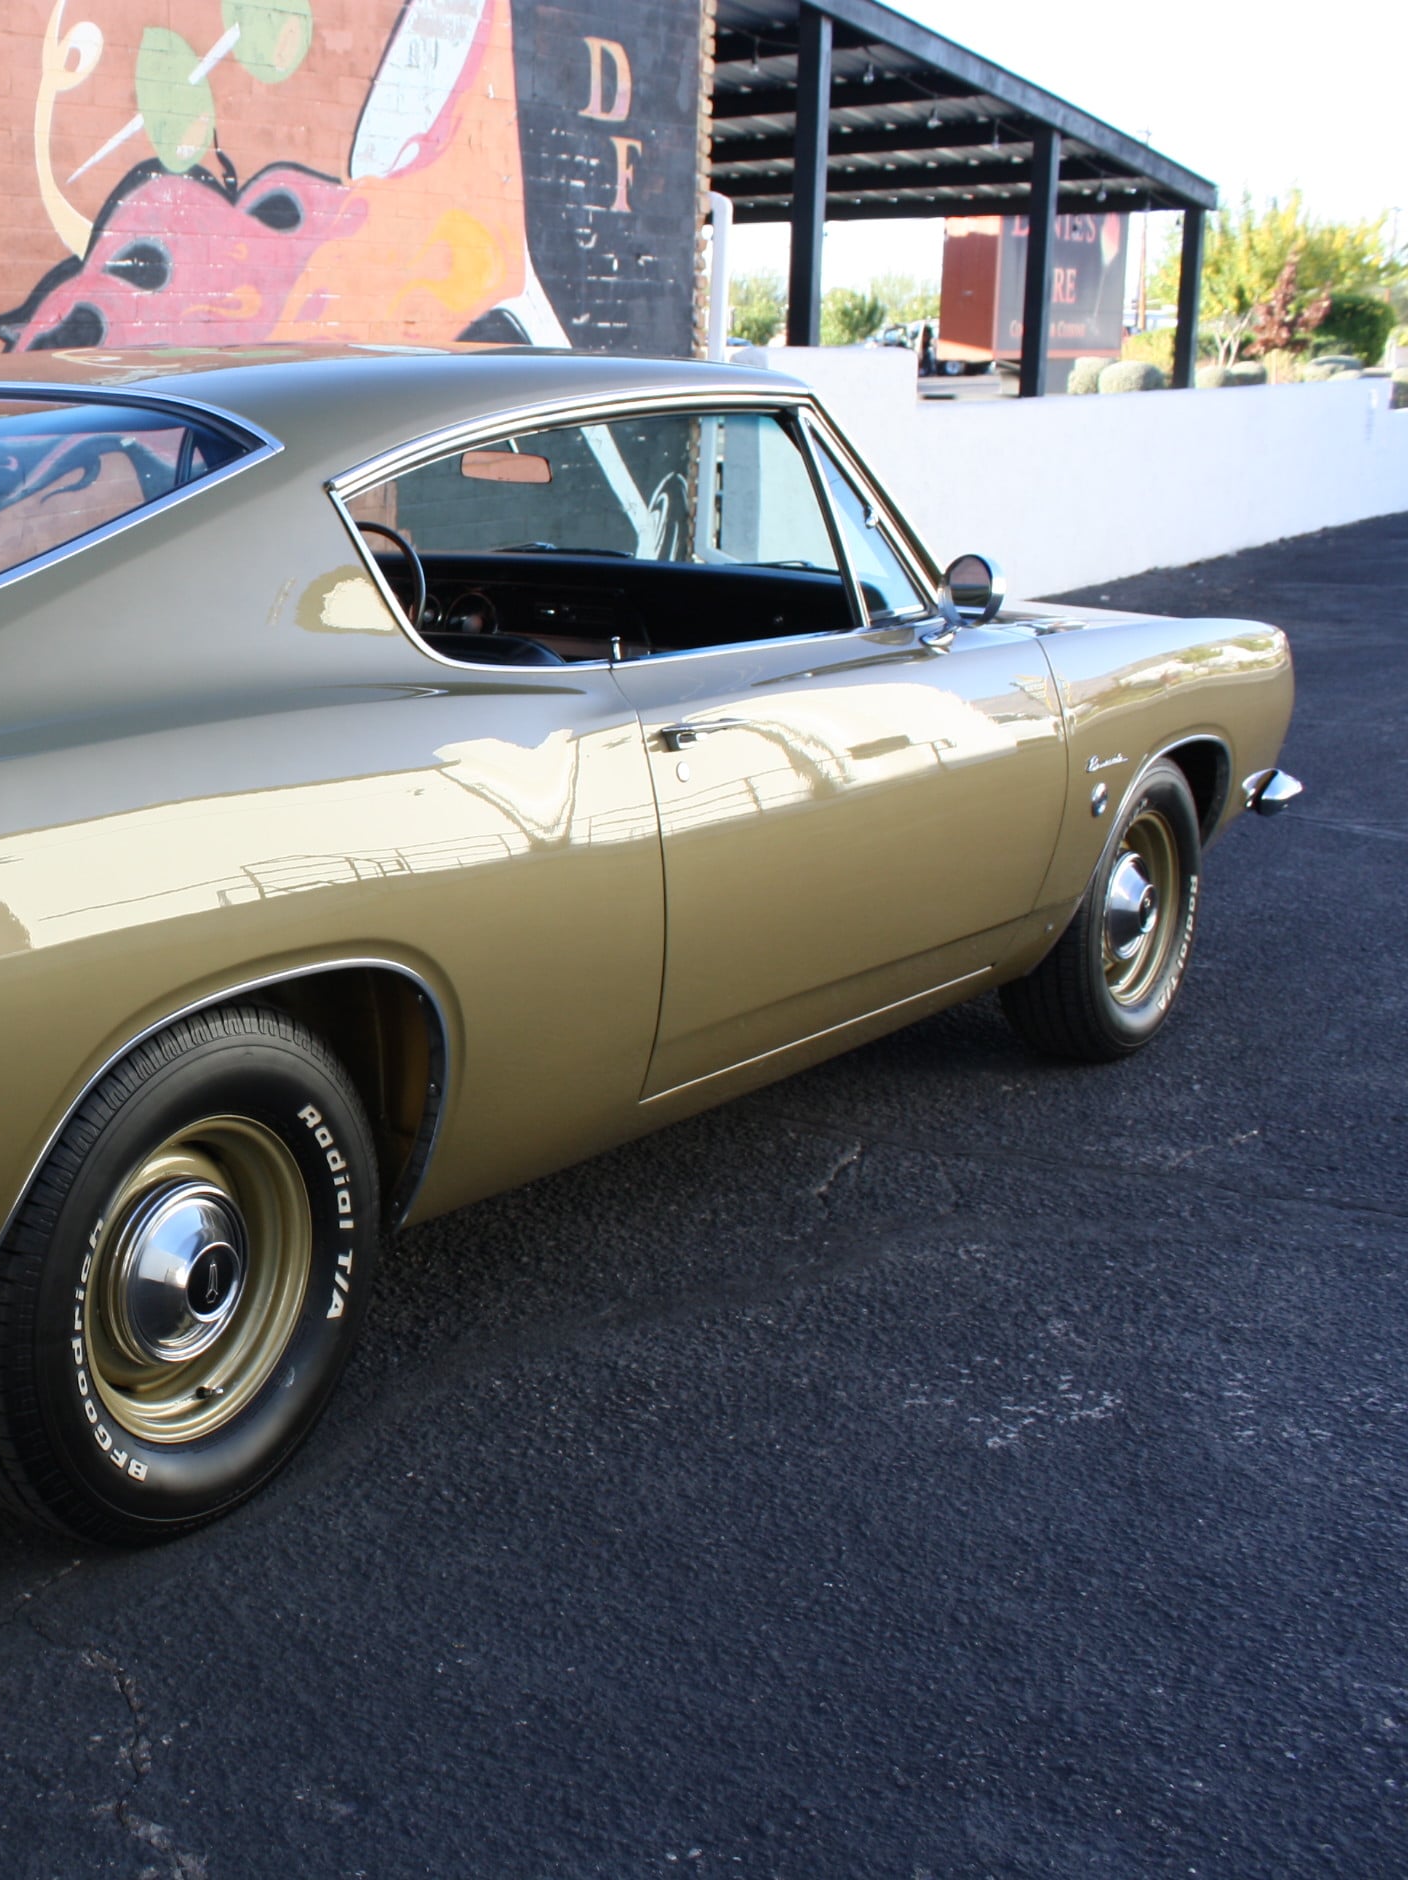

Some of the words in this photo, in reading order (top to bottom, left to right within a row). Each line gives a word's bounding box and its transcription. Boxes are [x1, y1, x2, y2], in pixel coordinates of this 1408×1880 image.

[578, 36, 633, 122] D
[607, 136, 643, 213] F
[1052, 268, 1077, 304] RE
[297, 1103, 354, 1229] Radial
[327, 1248, 357, 1320] T/A
[70, 1217, 150, 1482] BFGoodrich
